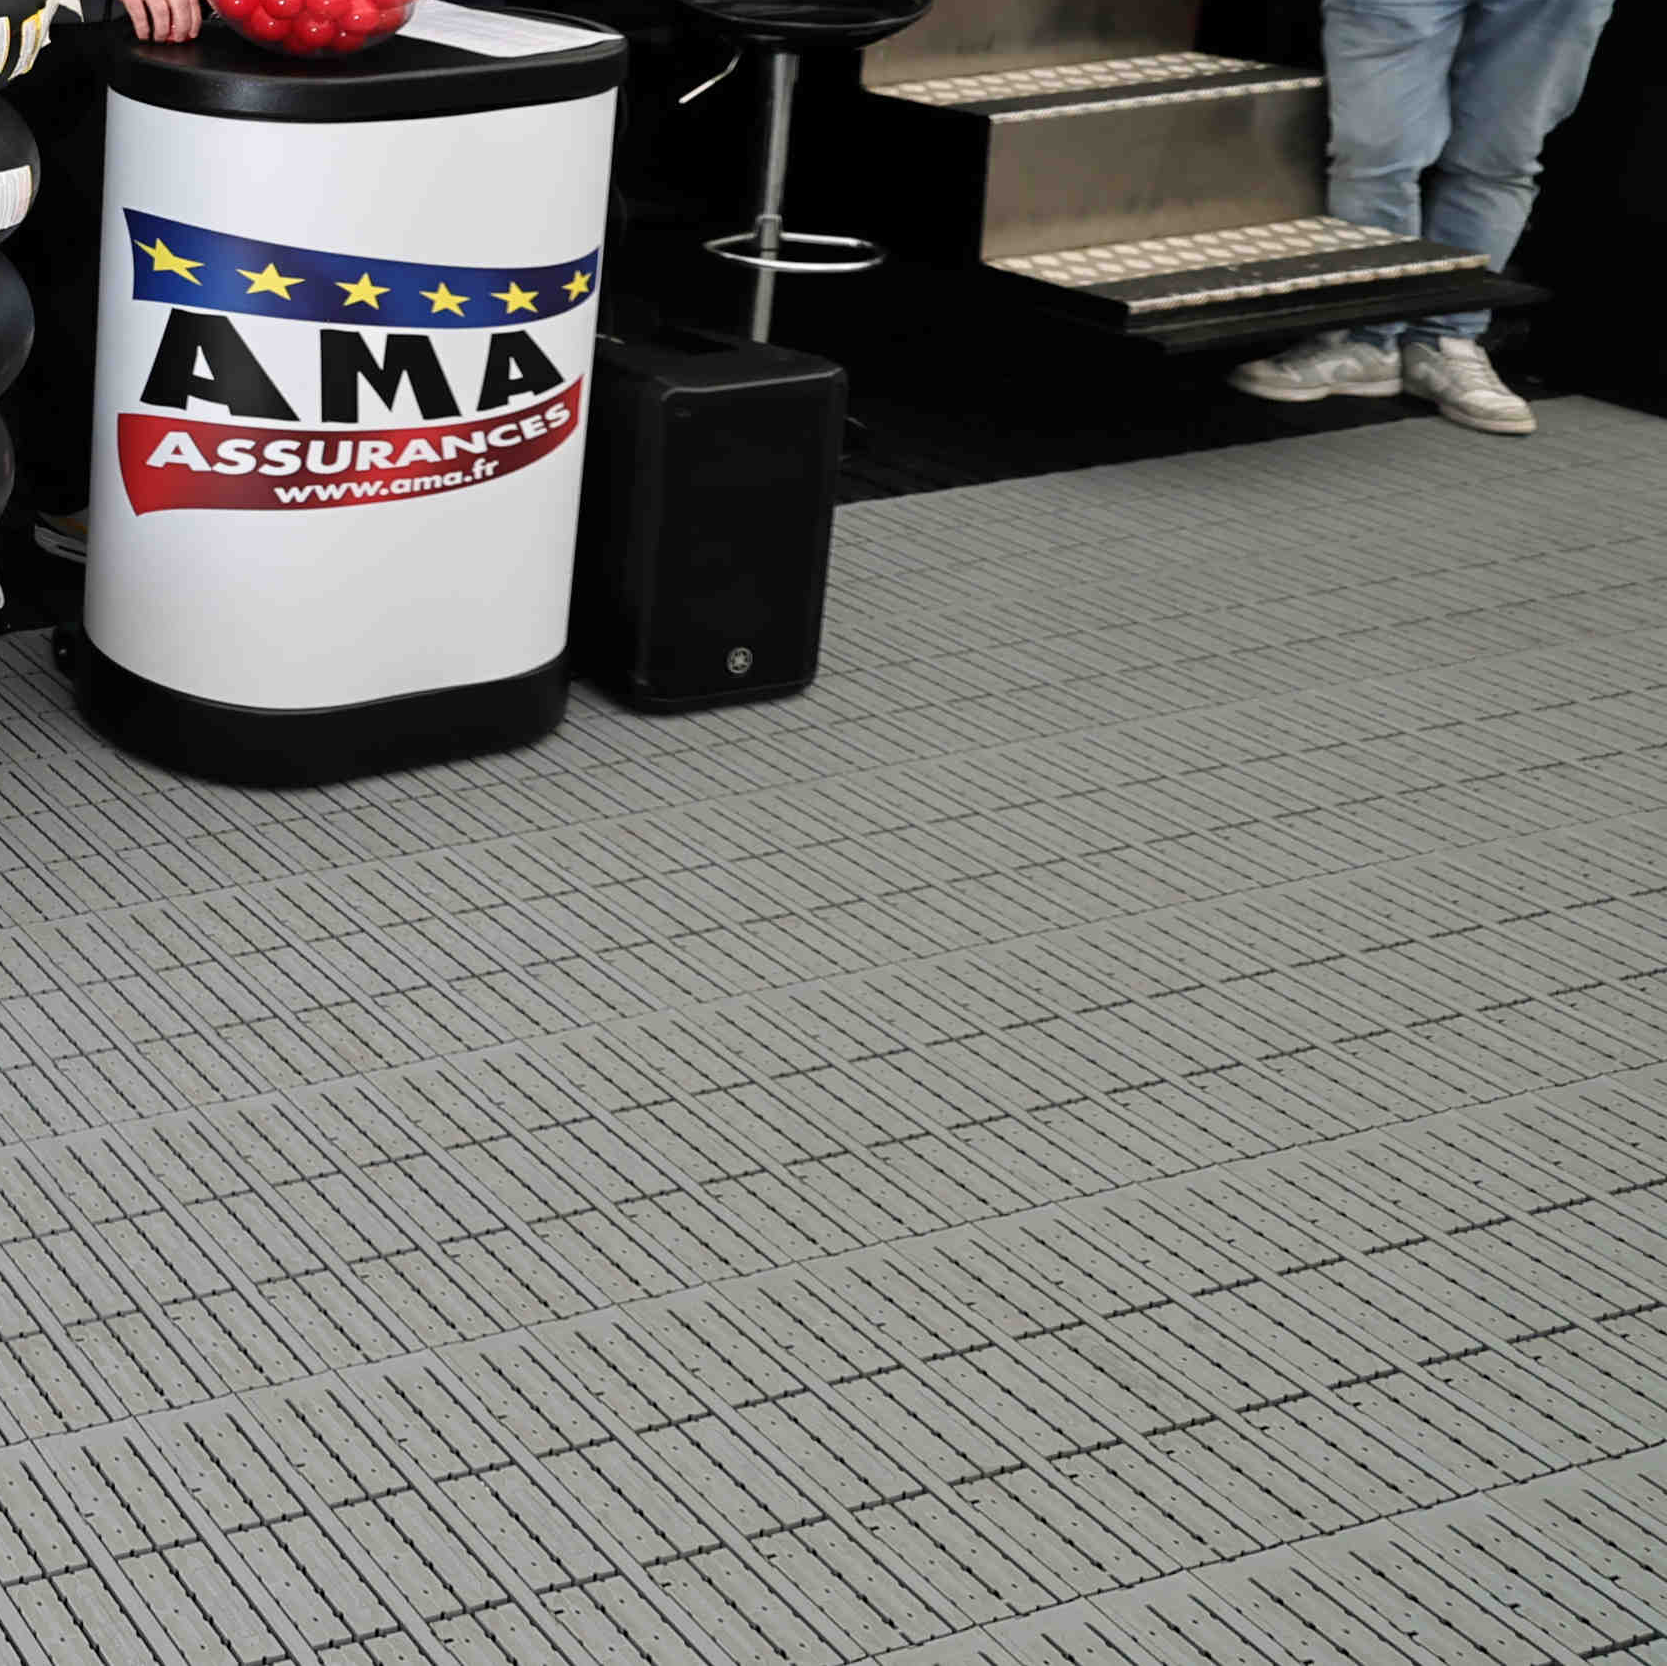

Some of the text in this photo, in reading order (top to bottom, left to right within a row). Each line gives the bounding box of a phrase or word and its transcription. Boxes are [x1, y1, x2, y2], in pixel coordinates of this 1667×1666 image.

[140, 307, 565, 423] AMA
[146, 401, 572, 476] ASSURANCES
[274, 458, 500, 504] www.ama.fr
